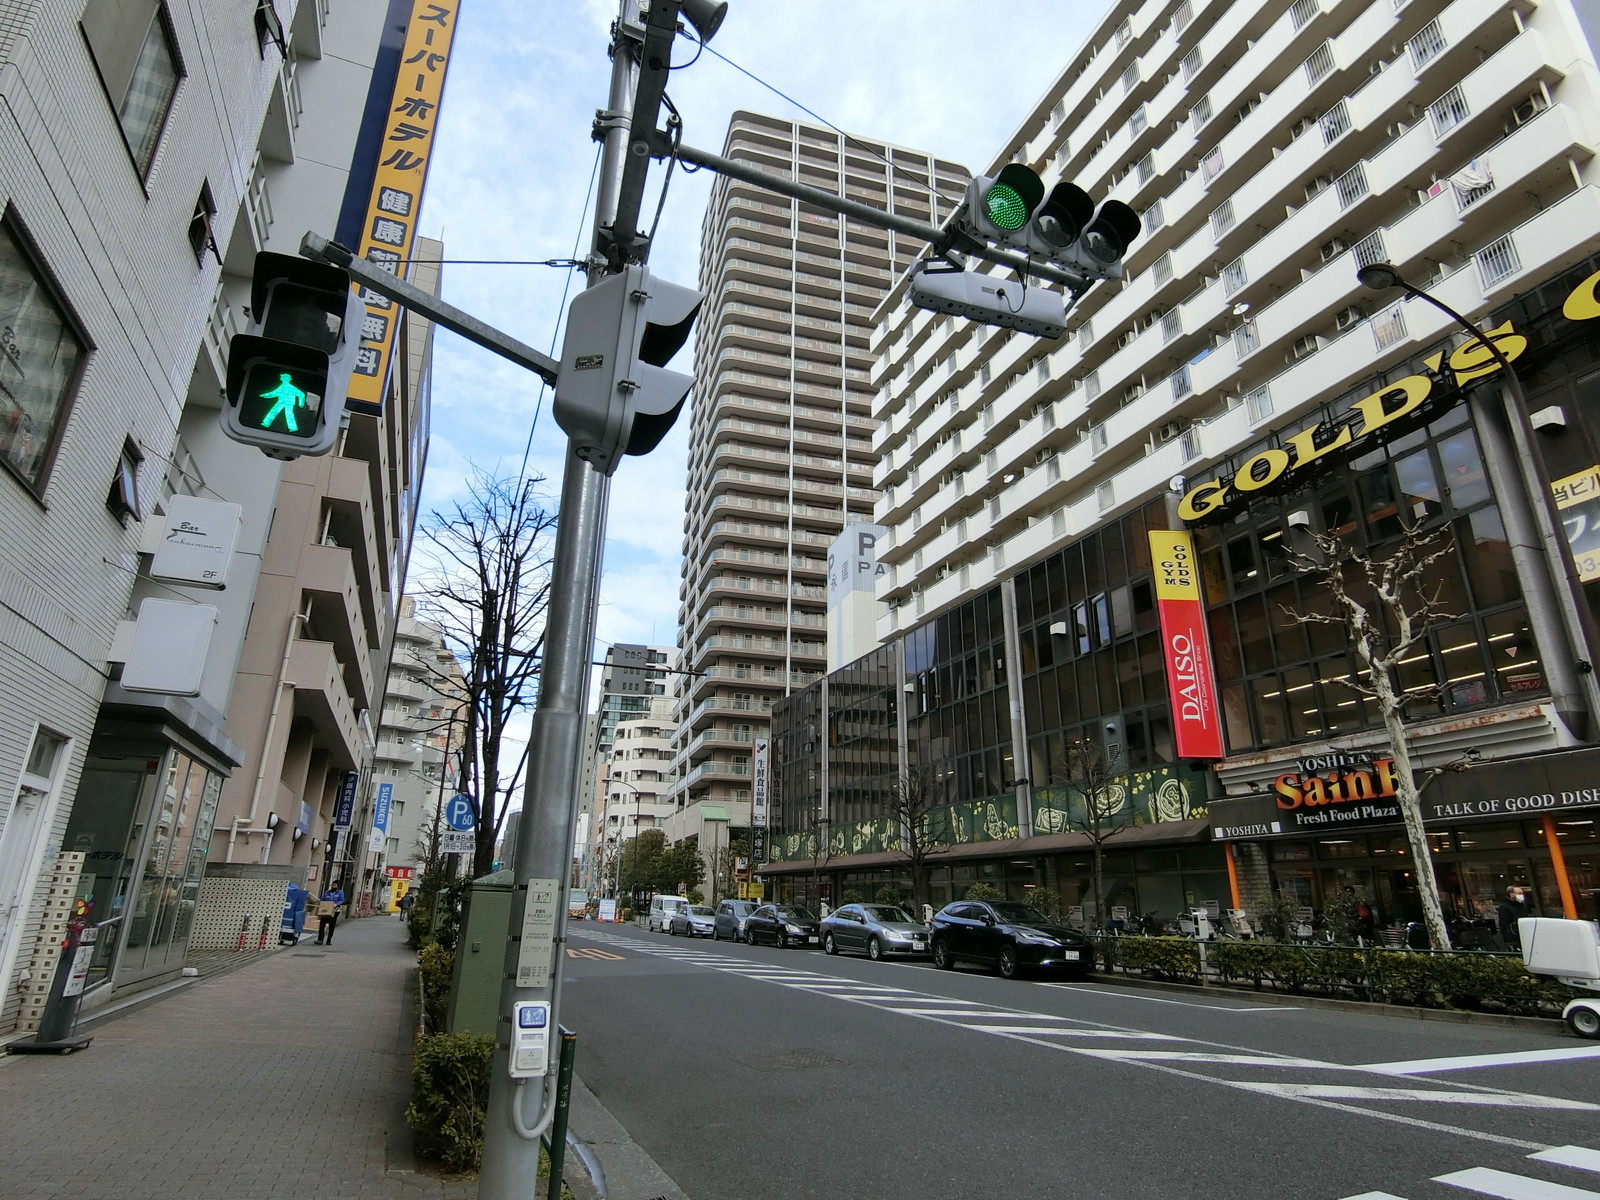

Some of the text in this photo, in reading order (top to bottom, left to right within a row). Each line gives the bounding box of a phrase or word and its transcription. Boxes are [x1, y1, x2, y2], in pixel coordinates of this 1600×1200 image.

[380, 3, 451, 171] スーパーホテル
[1176, 319, 1529, 521] GOLD'S
[180, 521, 200, 532] Bar
[858, 532, 877, 557] P
[202, 570, 218, 579] 2F
[1160, 561, 1177, 586] GYM
[1172, 634, 1202, 722] DAISO
[452, 801, 468, 825] P
[1296, 805, 1397, 825] Fresh Food Plaza
[1433, 801, 1474, 817] TALK
[1478, 799, 1501, 813] OF
[1505, 793, 1555, 812] GOOD
[462, 814, 473, 826] 60
[1225, 824, 1269, 837] YOSHIYA
